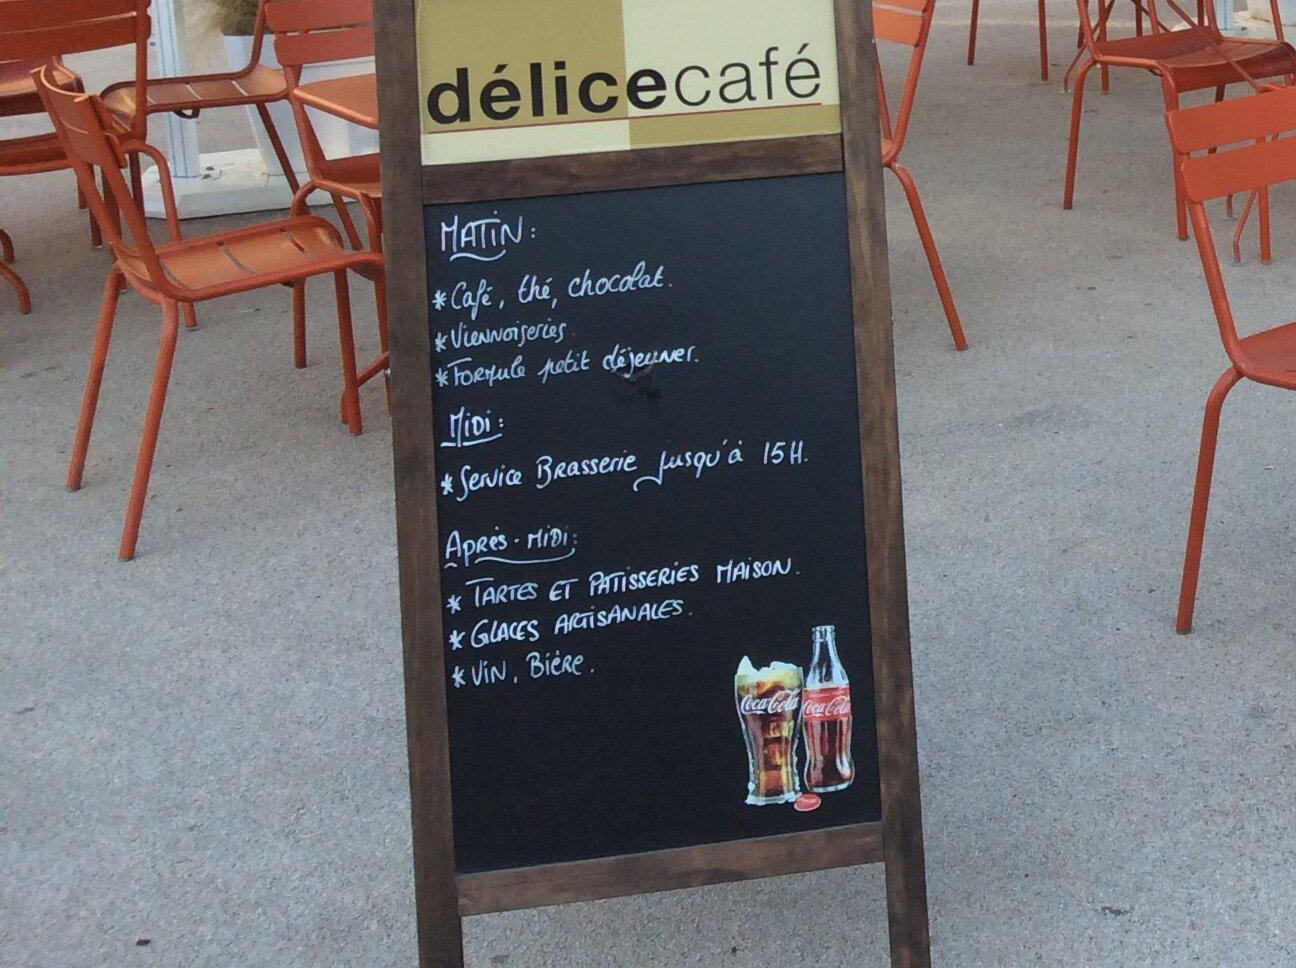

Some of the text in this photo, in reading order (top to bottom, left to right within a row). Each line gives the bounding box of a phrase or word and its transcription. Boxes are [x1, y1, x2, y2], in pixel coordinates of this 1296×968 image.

[426, 43, 821, 125] délicecafé
[538, 350, 591, 384] petit
[456, 464, 523, 502] Service
[535, 448, 638, 490] Brasserie
[465, 578, 539, 609] TARTES
[549, 577, 579, 602] ET
[470, 618, 540, 649] GLACES
